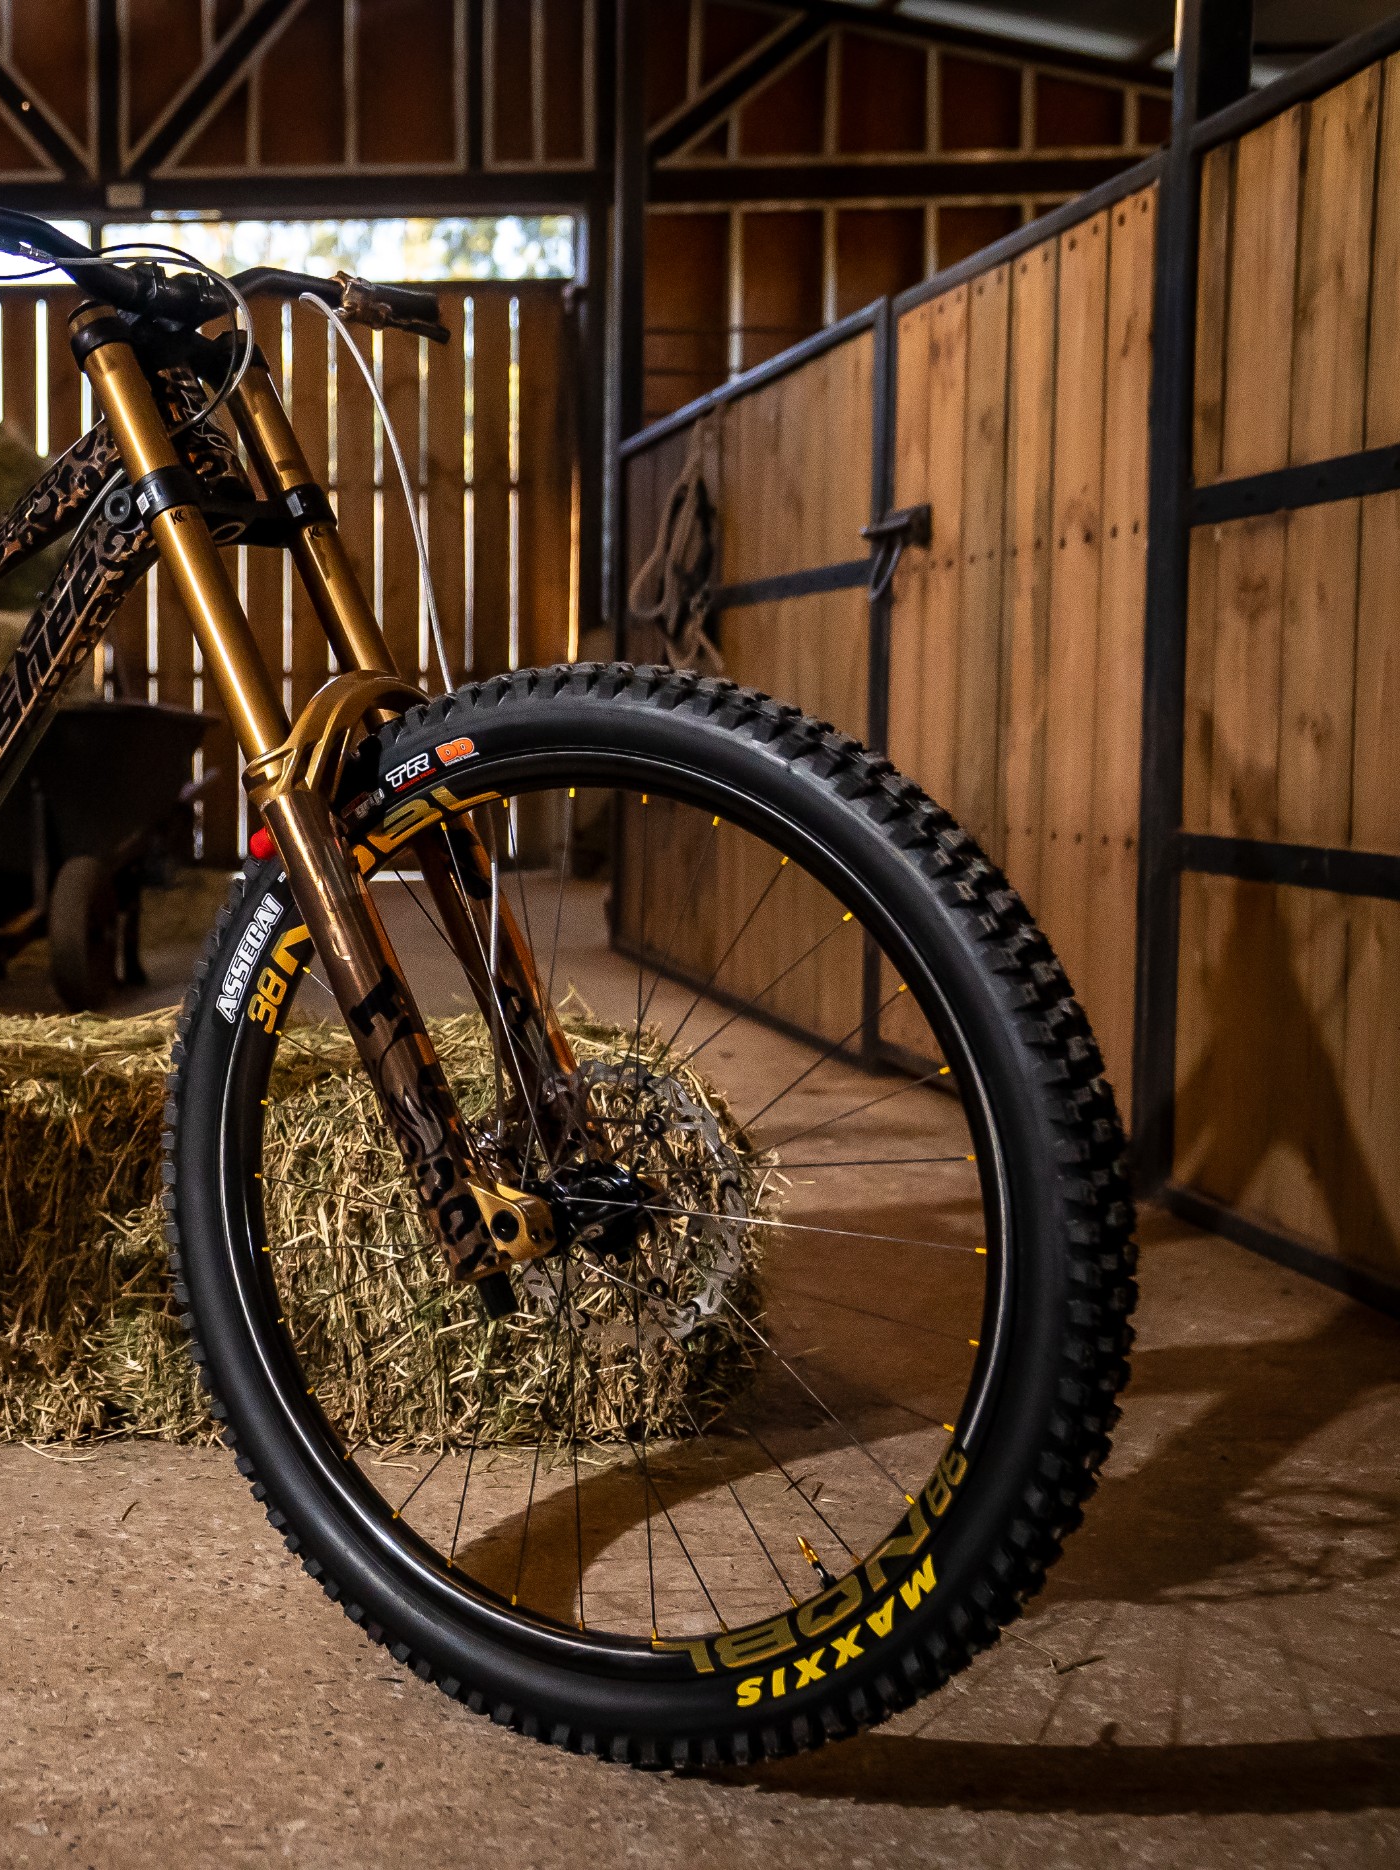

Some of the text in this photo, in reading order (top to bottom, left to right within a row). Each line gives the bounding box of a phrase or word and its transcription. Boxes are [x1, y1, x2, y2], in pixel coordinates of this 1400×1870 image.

[385, 753, 430, 788] TR
[215, 893, 285, 1023] ASSEGAI
[248, 966, 287, 1034] 38
[652, 1509, 931, 1673] NOBL
[736, 1554, 938, 1708] MAXXIS
